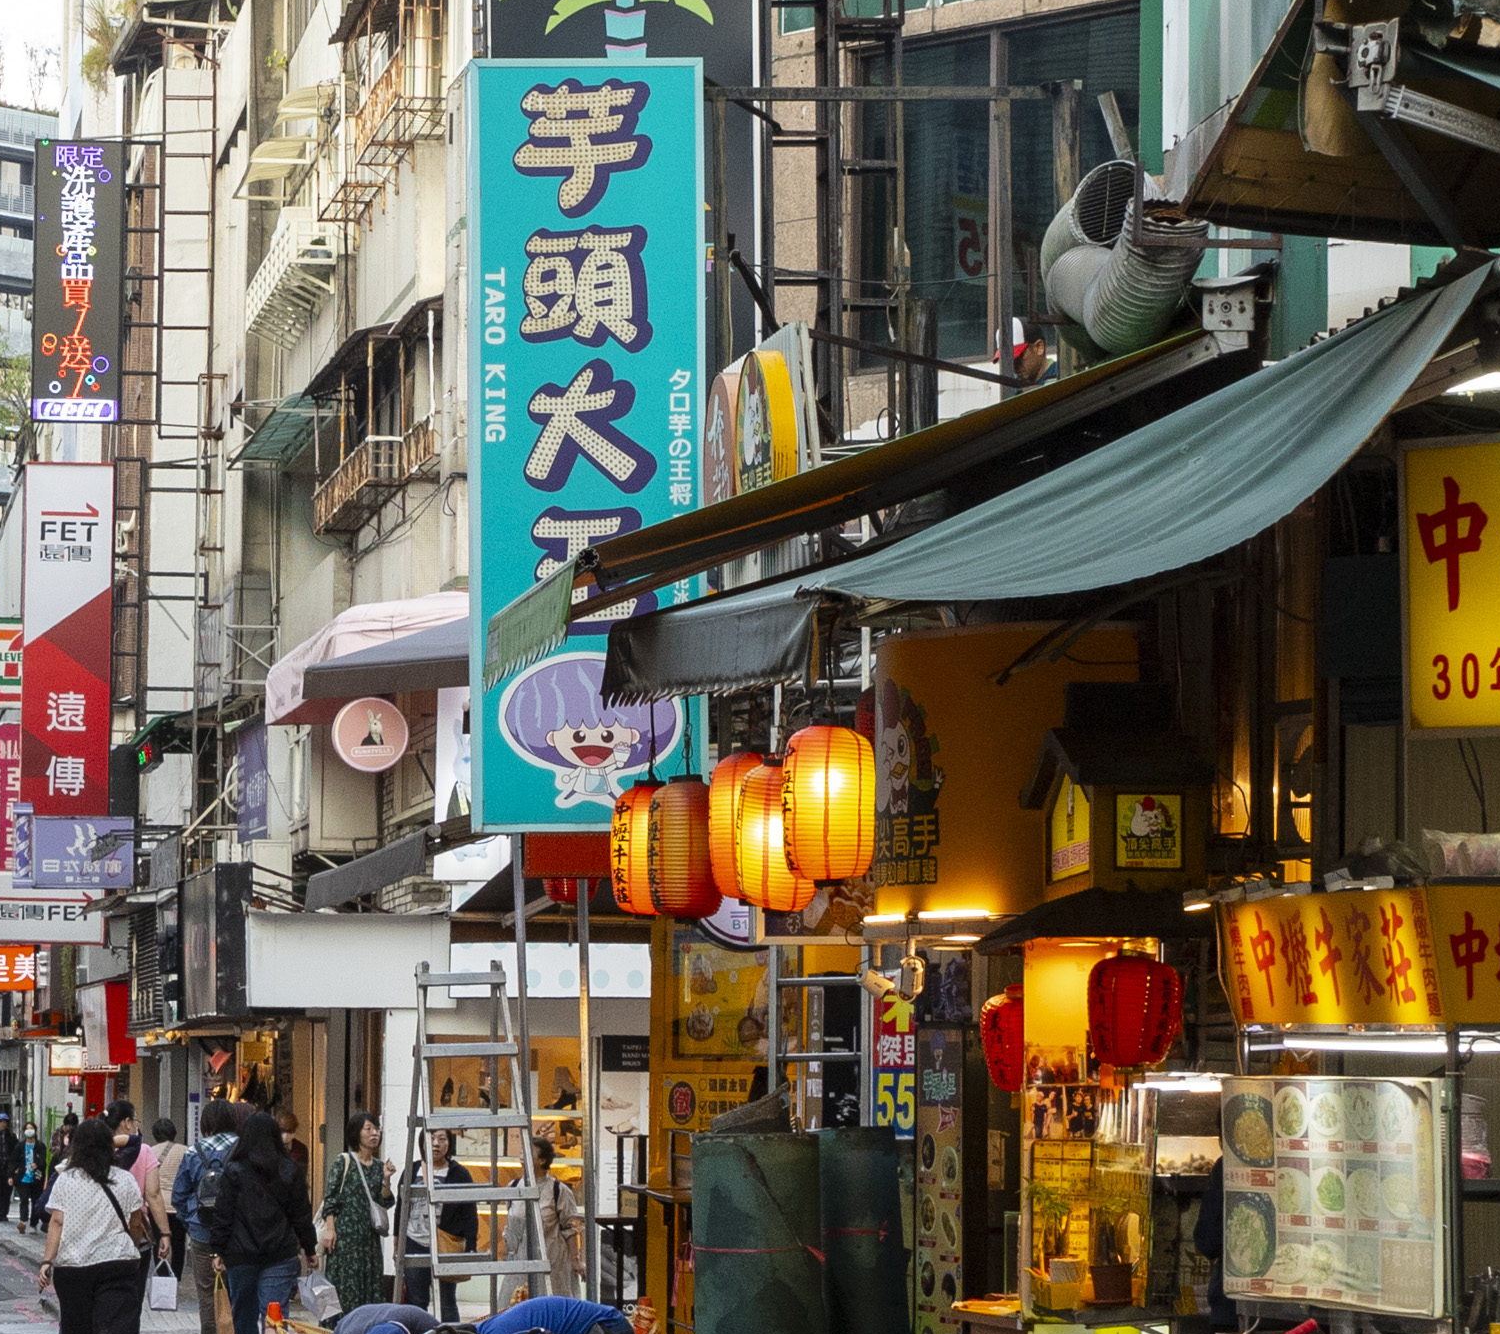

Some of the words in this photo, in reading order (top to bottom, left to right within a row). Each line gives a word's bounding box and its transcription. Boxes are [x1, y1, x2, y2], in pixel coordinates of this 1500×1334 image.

[55, 145, 104, 168] 限定
[483, 267, 505, 344] TARO
[513, 81, 648, 627] 芋頭大王
[483, 362, 505, 443] KING
[41, 521, 99, 543] FET
[46, 691, 87, 797] 遠傳
[611, 800, 632, 905] 中壢牛家莊
[876, 815, 936, 858] 尖高手
[732, 919, 748, 930] B1
